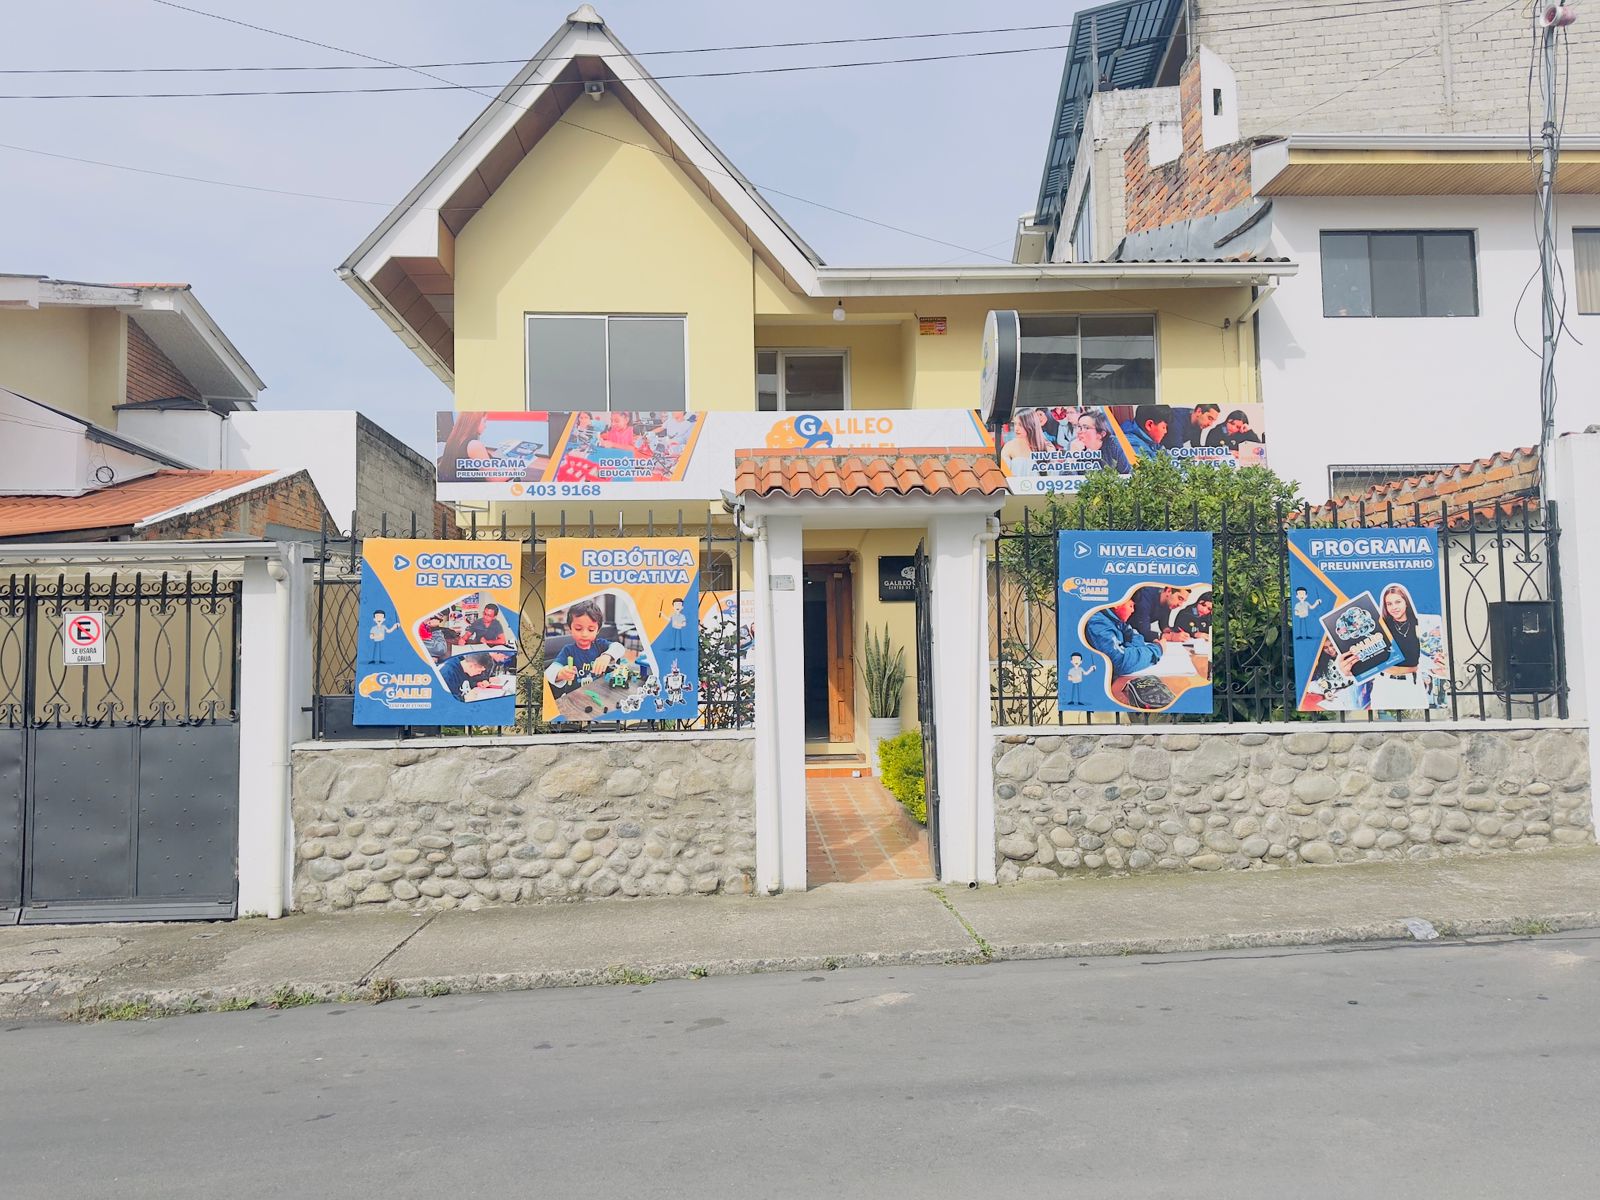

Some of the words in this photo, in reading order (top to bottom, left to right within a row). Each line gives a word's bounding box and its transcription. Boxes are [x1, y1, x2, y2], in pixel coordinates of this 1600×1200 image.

[800, 417, 894, 435] GALILEO
[1031, 449, 1101, 460] NIVELACIÓN
[1171, 447, 1232, 457] CONTROL
[456, 458, 527, 468] PROGRAMA
[599, 456, 654, 468] ROBÓTICA
[1031, 461, 1101, 471] ACADÉMICA
[456, 470, 527, 478] PREUNIVERSITARIO
[599, 469, 652, 477] EDUCATIVA
[526, 484, 557, 496] 403
[562, 484, 601, 496] 9168
[1099, 543, 1197, 558] NIVELACIÓN
[1310, 538, 1432, 556] PROGRAMA
[417, 554, 512, 569] CONTROL
[582, 547, 694, 567] ROBÓTICA
[1104, 560, 1199, 575] ACADÉMICA
[1320, 559, 1433, 571] PREUNIVERSITARIO
[416, 574, 438, 586] DE
[442, 574, 512, 588] TAREAS
[589, 570, 690, 584] EDUCATIVA
[379, 673, 431, 685] GALILEO
[385, 687, 432, 699] GALILEI
